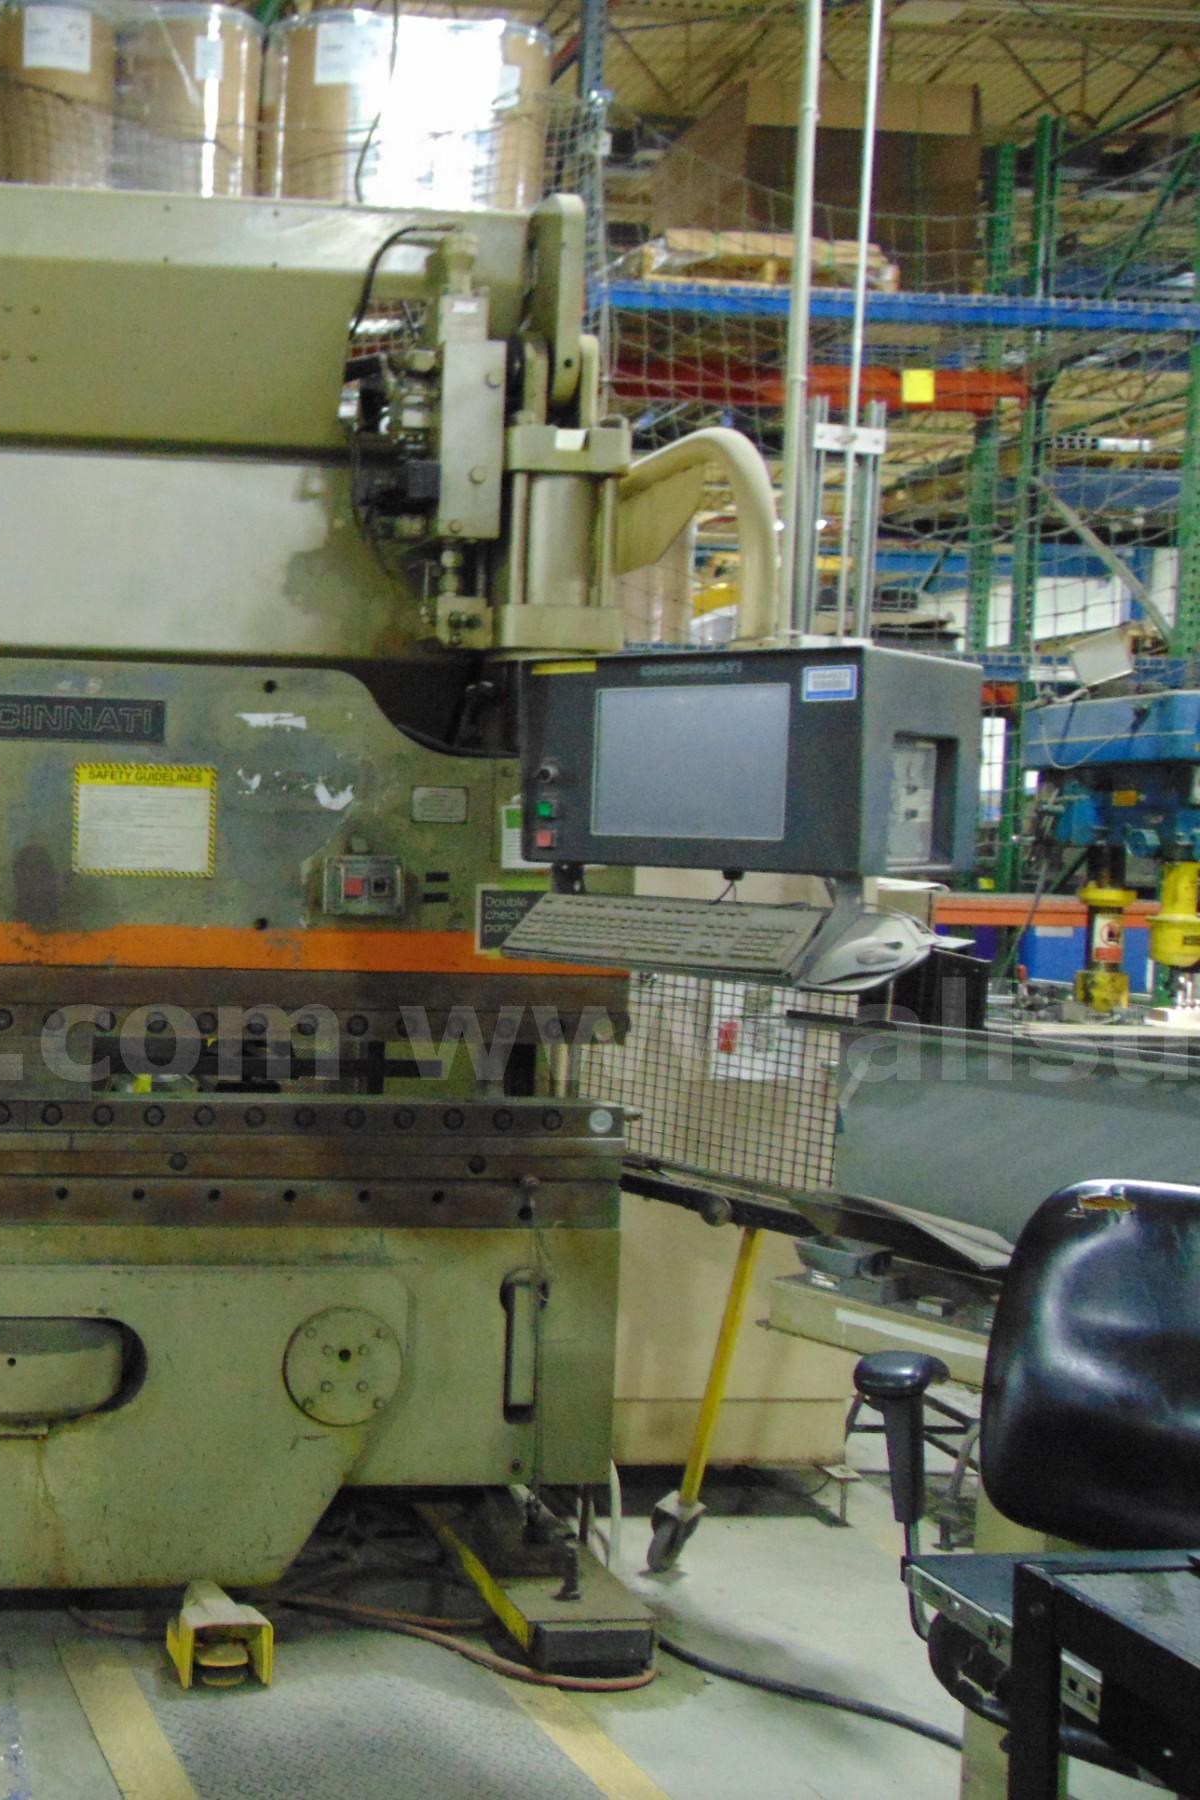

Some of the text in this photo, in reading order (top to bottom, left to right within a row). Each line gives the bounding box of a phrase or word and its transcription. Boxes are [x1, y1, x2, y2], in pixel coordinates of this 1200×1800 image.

[87, 769, 203, 783] SAFETY GUIDELINES
[484, 895, 529, 908] Double
